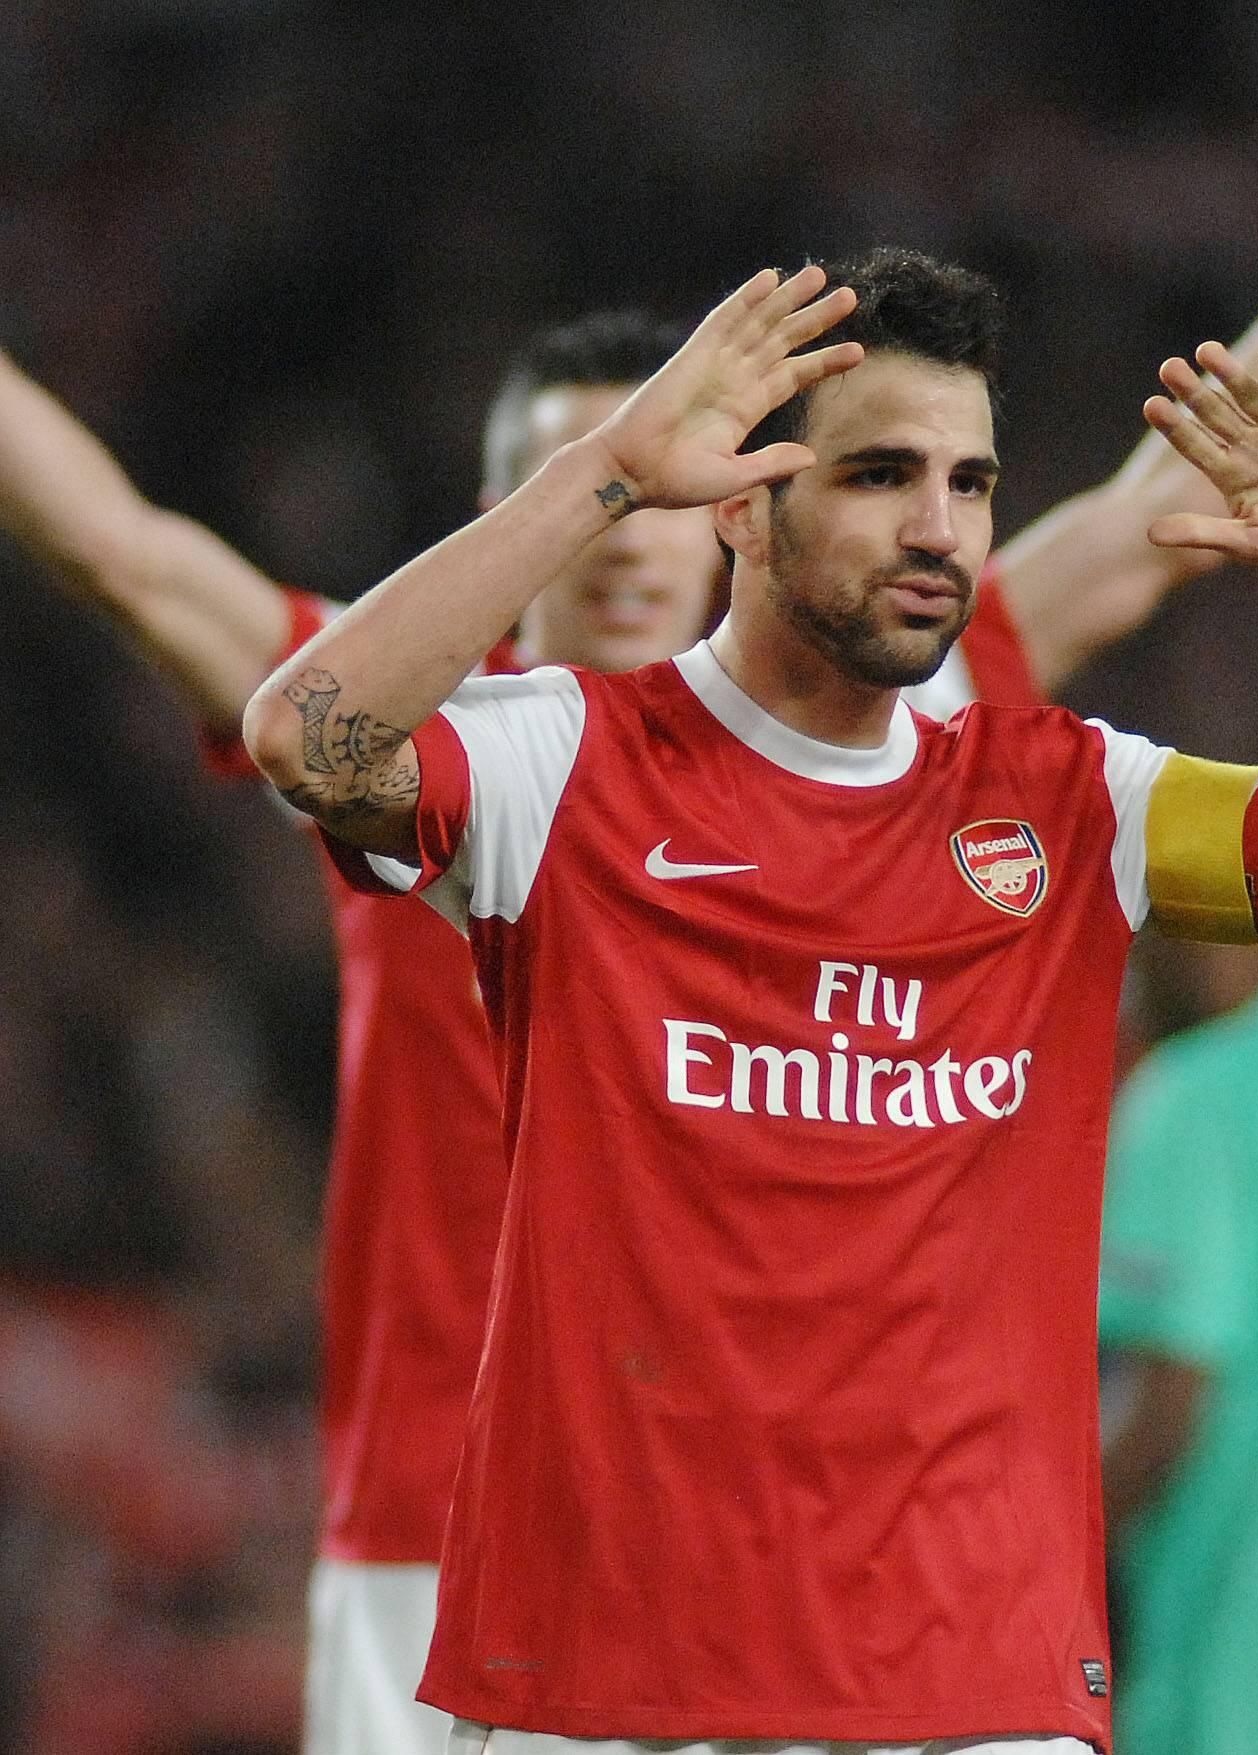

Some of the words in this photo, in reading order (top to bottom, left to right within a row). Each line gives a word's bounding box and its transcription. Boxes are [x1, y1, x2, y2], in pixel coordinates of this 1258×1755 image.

[965, 832, 1028, 858] Arsenal
[814, 960, 923, 1040] Fly
[662, 1018, 1033, 1128] Emirates
